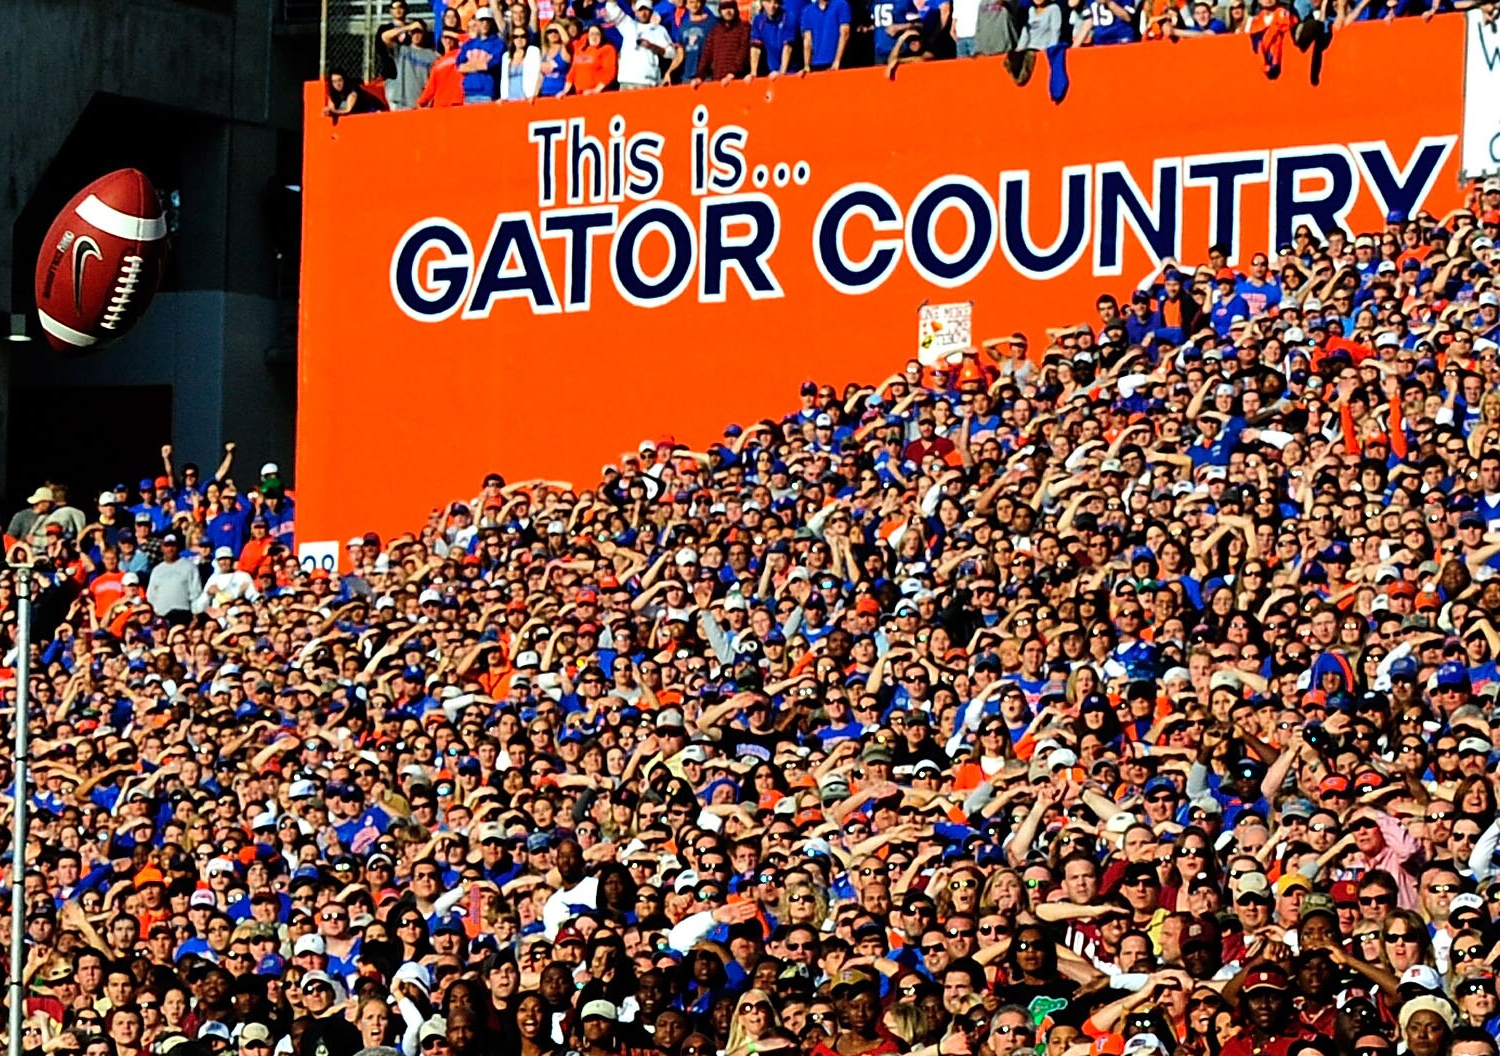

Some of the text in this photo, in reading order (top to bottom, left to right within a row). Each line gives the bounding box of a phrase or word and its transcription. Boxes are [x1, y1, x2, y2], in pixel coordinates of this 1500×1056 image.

[874, 3, 894, 28] 15
[528, 104, 810, 207] This is...
[389, 134, 1457, 322] GATOR COUNTRY
